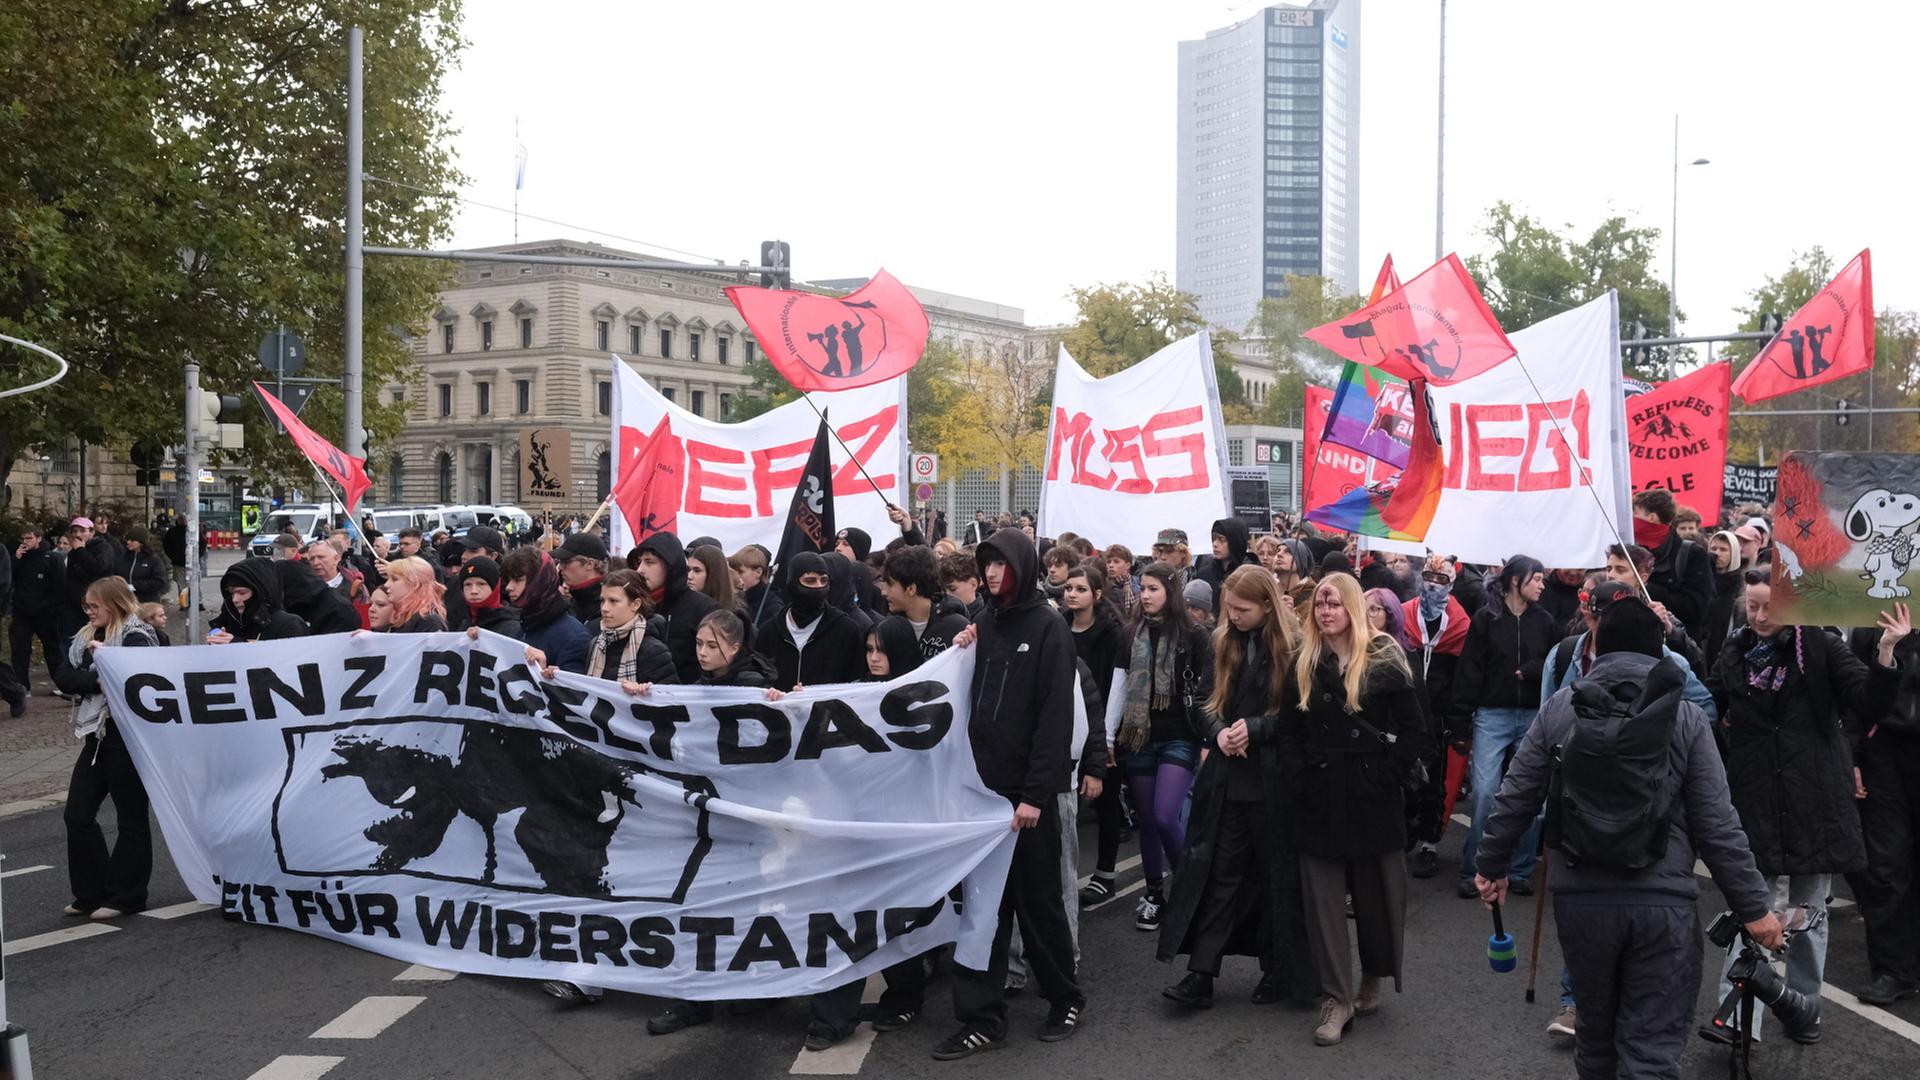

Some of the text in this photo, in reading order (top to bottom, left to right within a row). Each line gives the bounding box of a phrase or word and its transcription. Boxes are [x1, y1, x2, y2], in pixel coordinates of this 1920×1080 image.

[920, 461, 930, 470] 20
[1047, 405, 1210, 494] MUSS
[1257, 445, 1270, 460] DB
[711, 681, 954, 765] DAS
[213, 873, 279, 923] EIT
[286, 880, 400, 938] FÜR
